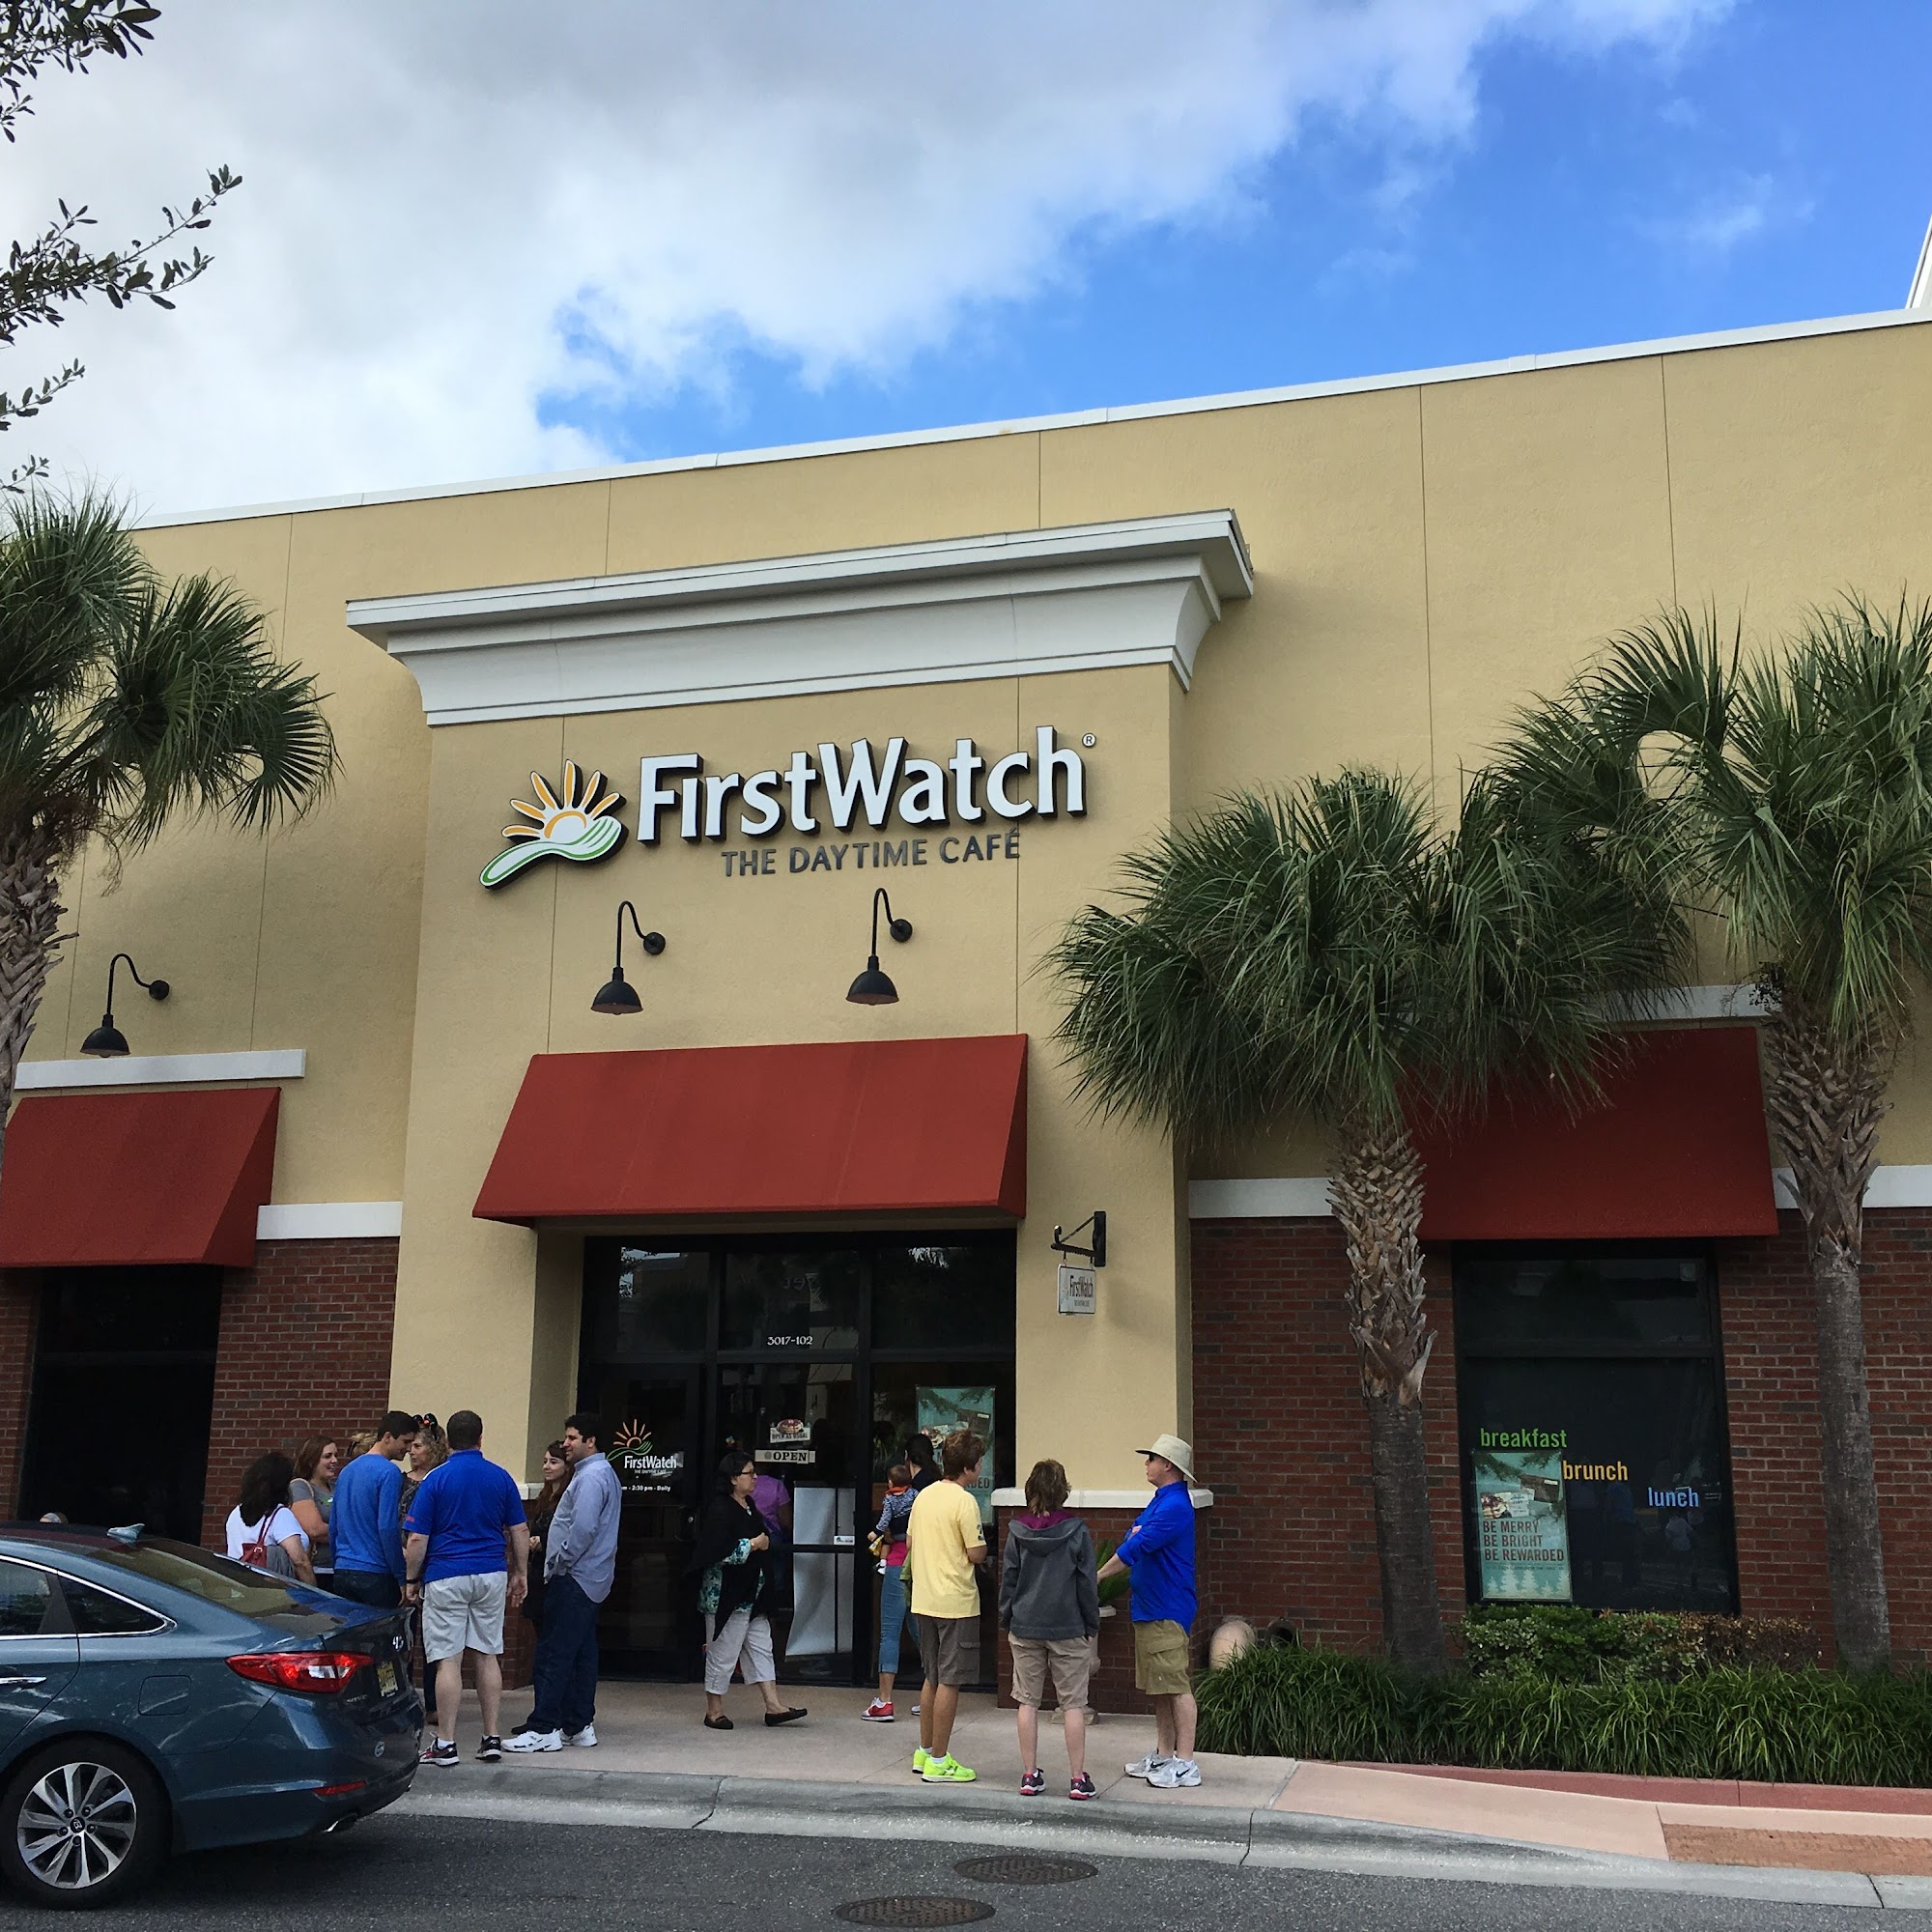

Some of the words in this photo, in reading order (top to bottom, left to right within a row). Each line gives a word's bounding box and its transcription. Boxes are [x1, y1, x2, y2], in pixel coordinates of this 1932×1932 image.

[637, 726, 1087, 842] FirstWatch
[722, 846, 777, 877] THE
[788, 838, 927, 874] DAYTIME
[940, 827, 1020, 866] CAFÉ
[766, 1335, 813, 1346] 3017-102
[1480, 1428, 1568, 1448] breakfast
[624, 1455, 677, 1469] FirstWatch
[773, 1451, 808, 1462] OPEN
[1562, 1460, 1629, 1481] brunch
[1648, 1487, 1700, 1508] lunch
[1483, 1520, 1497, 1533] BE
[1500, 1520, 1540, 1533] MERRY
[1484, 1535, 1497, 1547] BE
[1501, 1534, 1543, 1547] BRIGHT
[1485, 1548, 1499, 1561] BE
[1503, 1548, 1565, 1561] REWARDED
